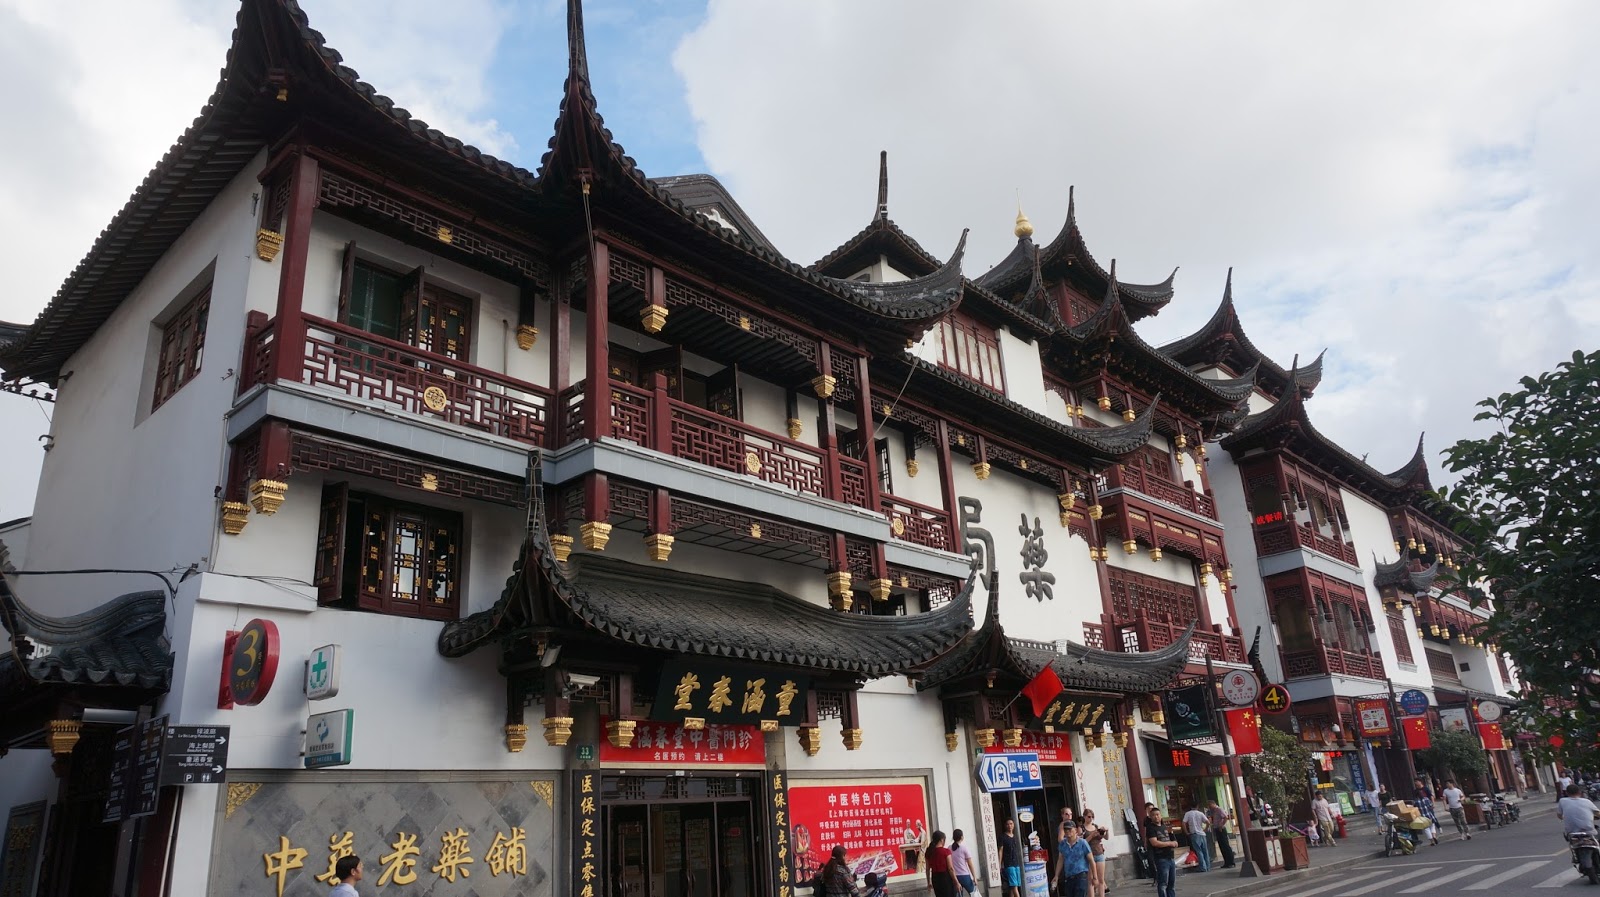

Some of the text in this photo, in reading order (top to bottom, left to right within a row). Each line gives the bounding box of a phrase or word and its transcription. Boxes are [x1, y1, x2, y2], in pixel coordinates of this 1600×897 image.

[236, 629, 259, 677] 3
[674, 671, 799, 716] 童涵春堂
[1265, 687, 1280, 704] 4
[637, 727, 752, 750] 涵春堂中醫門診
[186, 774, 192, 782] P
[828, 791, 892, 807] 中医特色门诊
